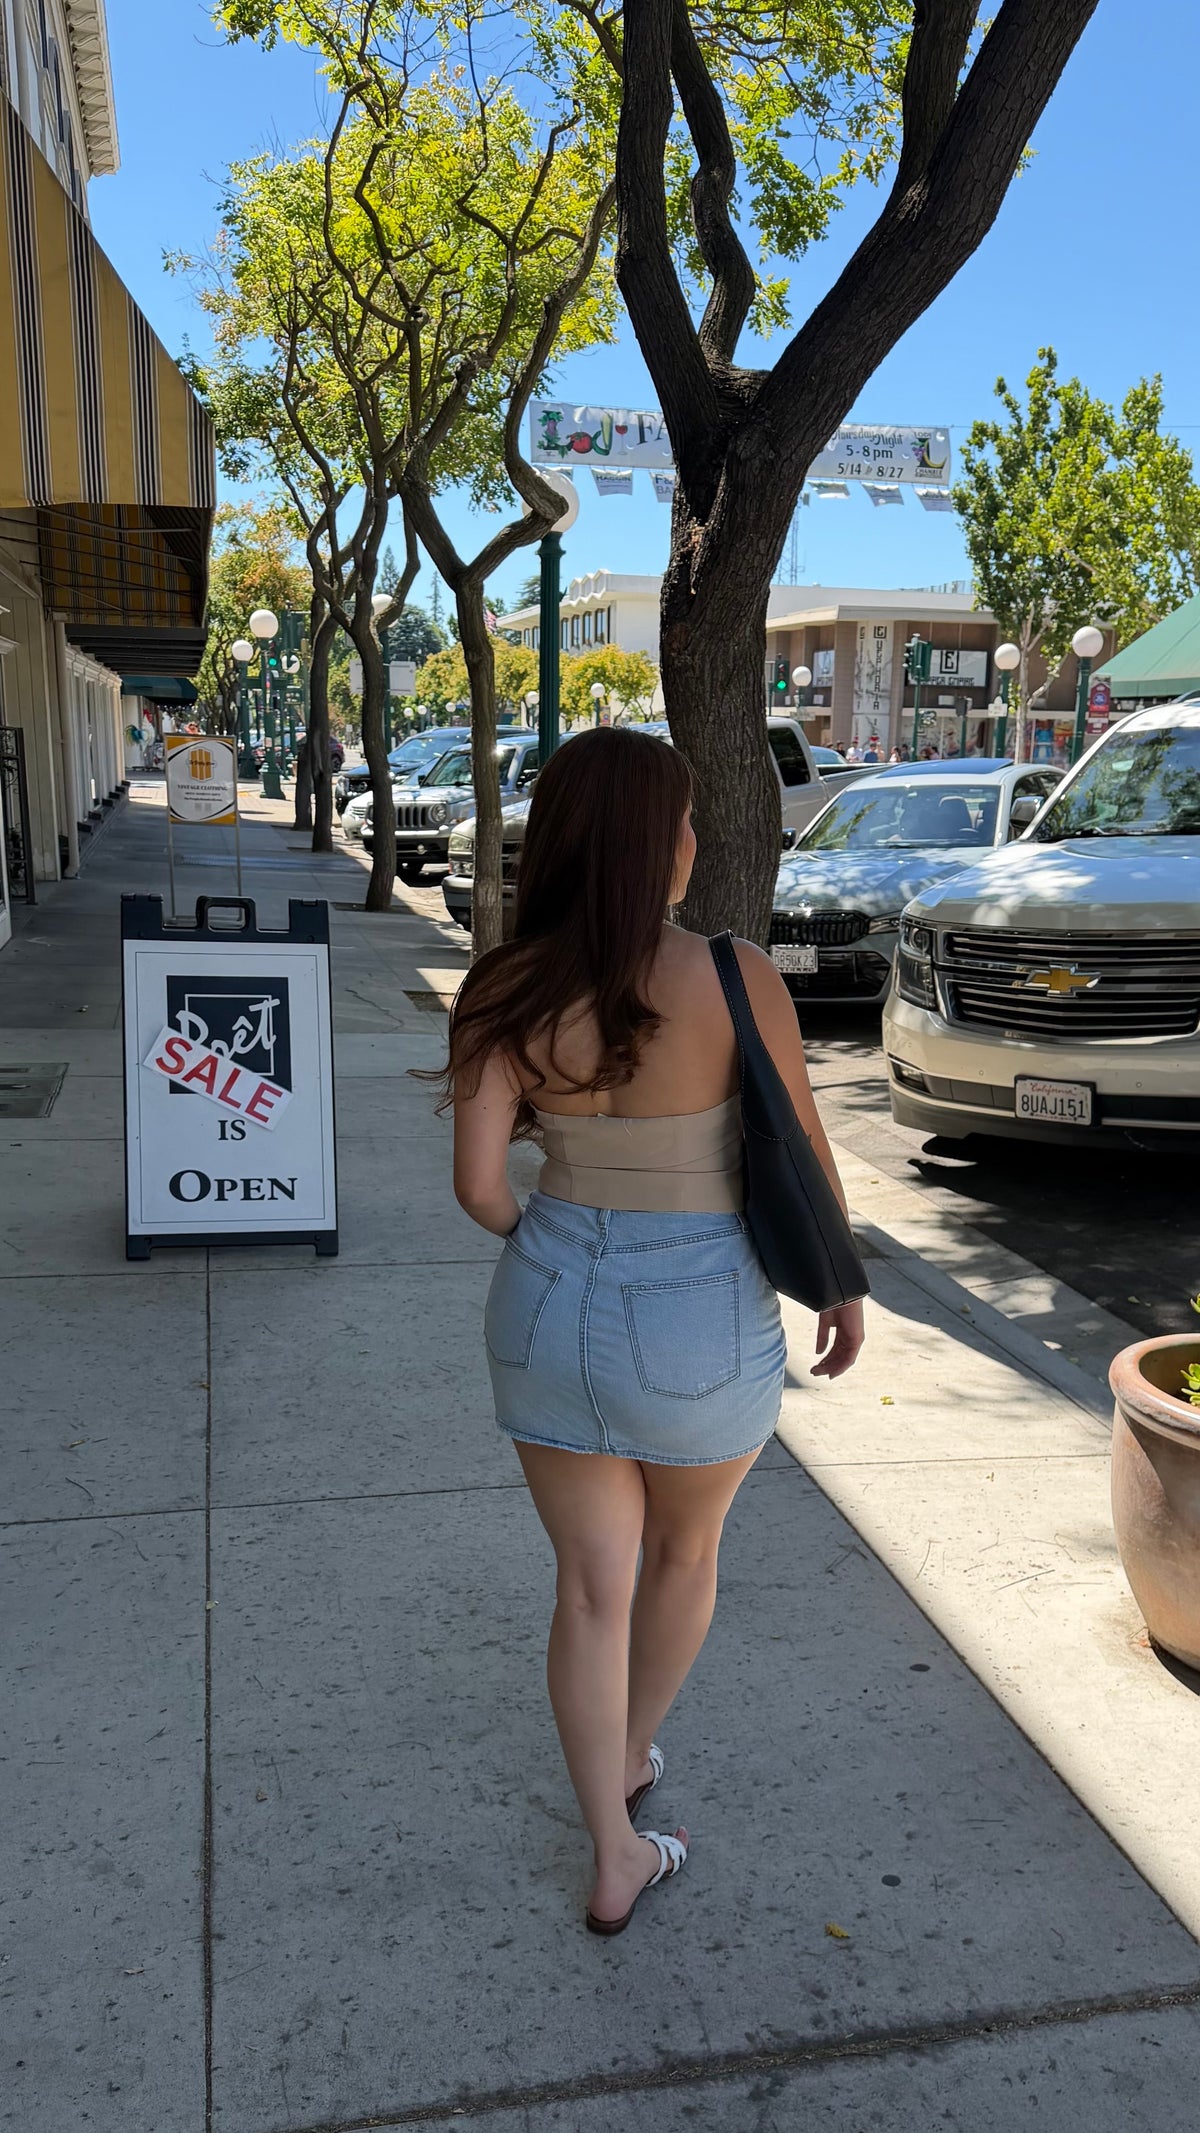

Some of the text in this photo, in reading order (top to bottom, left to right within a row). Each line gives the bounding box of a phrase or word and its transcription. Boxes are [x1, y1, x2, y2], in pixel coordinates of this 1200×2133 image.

[873, 449, 894, 461] pm
[837, 462, 862, 476] 5/14
[876, 465, 904, 479] 8/27
[155, 1036, 283, 1123] SALE
[1030, 1083, 1077, 1096] California
[1021, 1094, 1086, 1119] 8UAJ151
[217, 1119, 247, 1141] IS
[168, 1169, 298, 1203] OPEN
